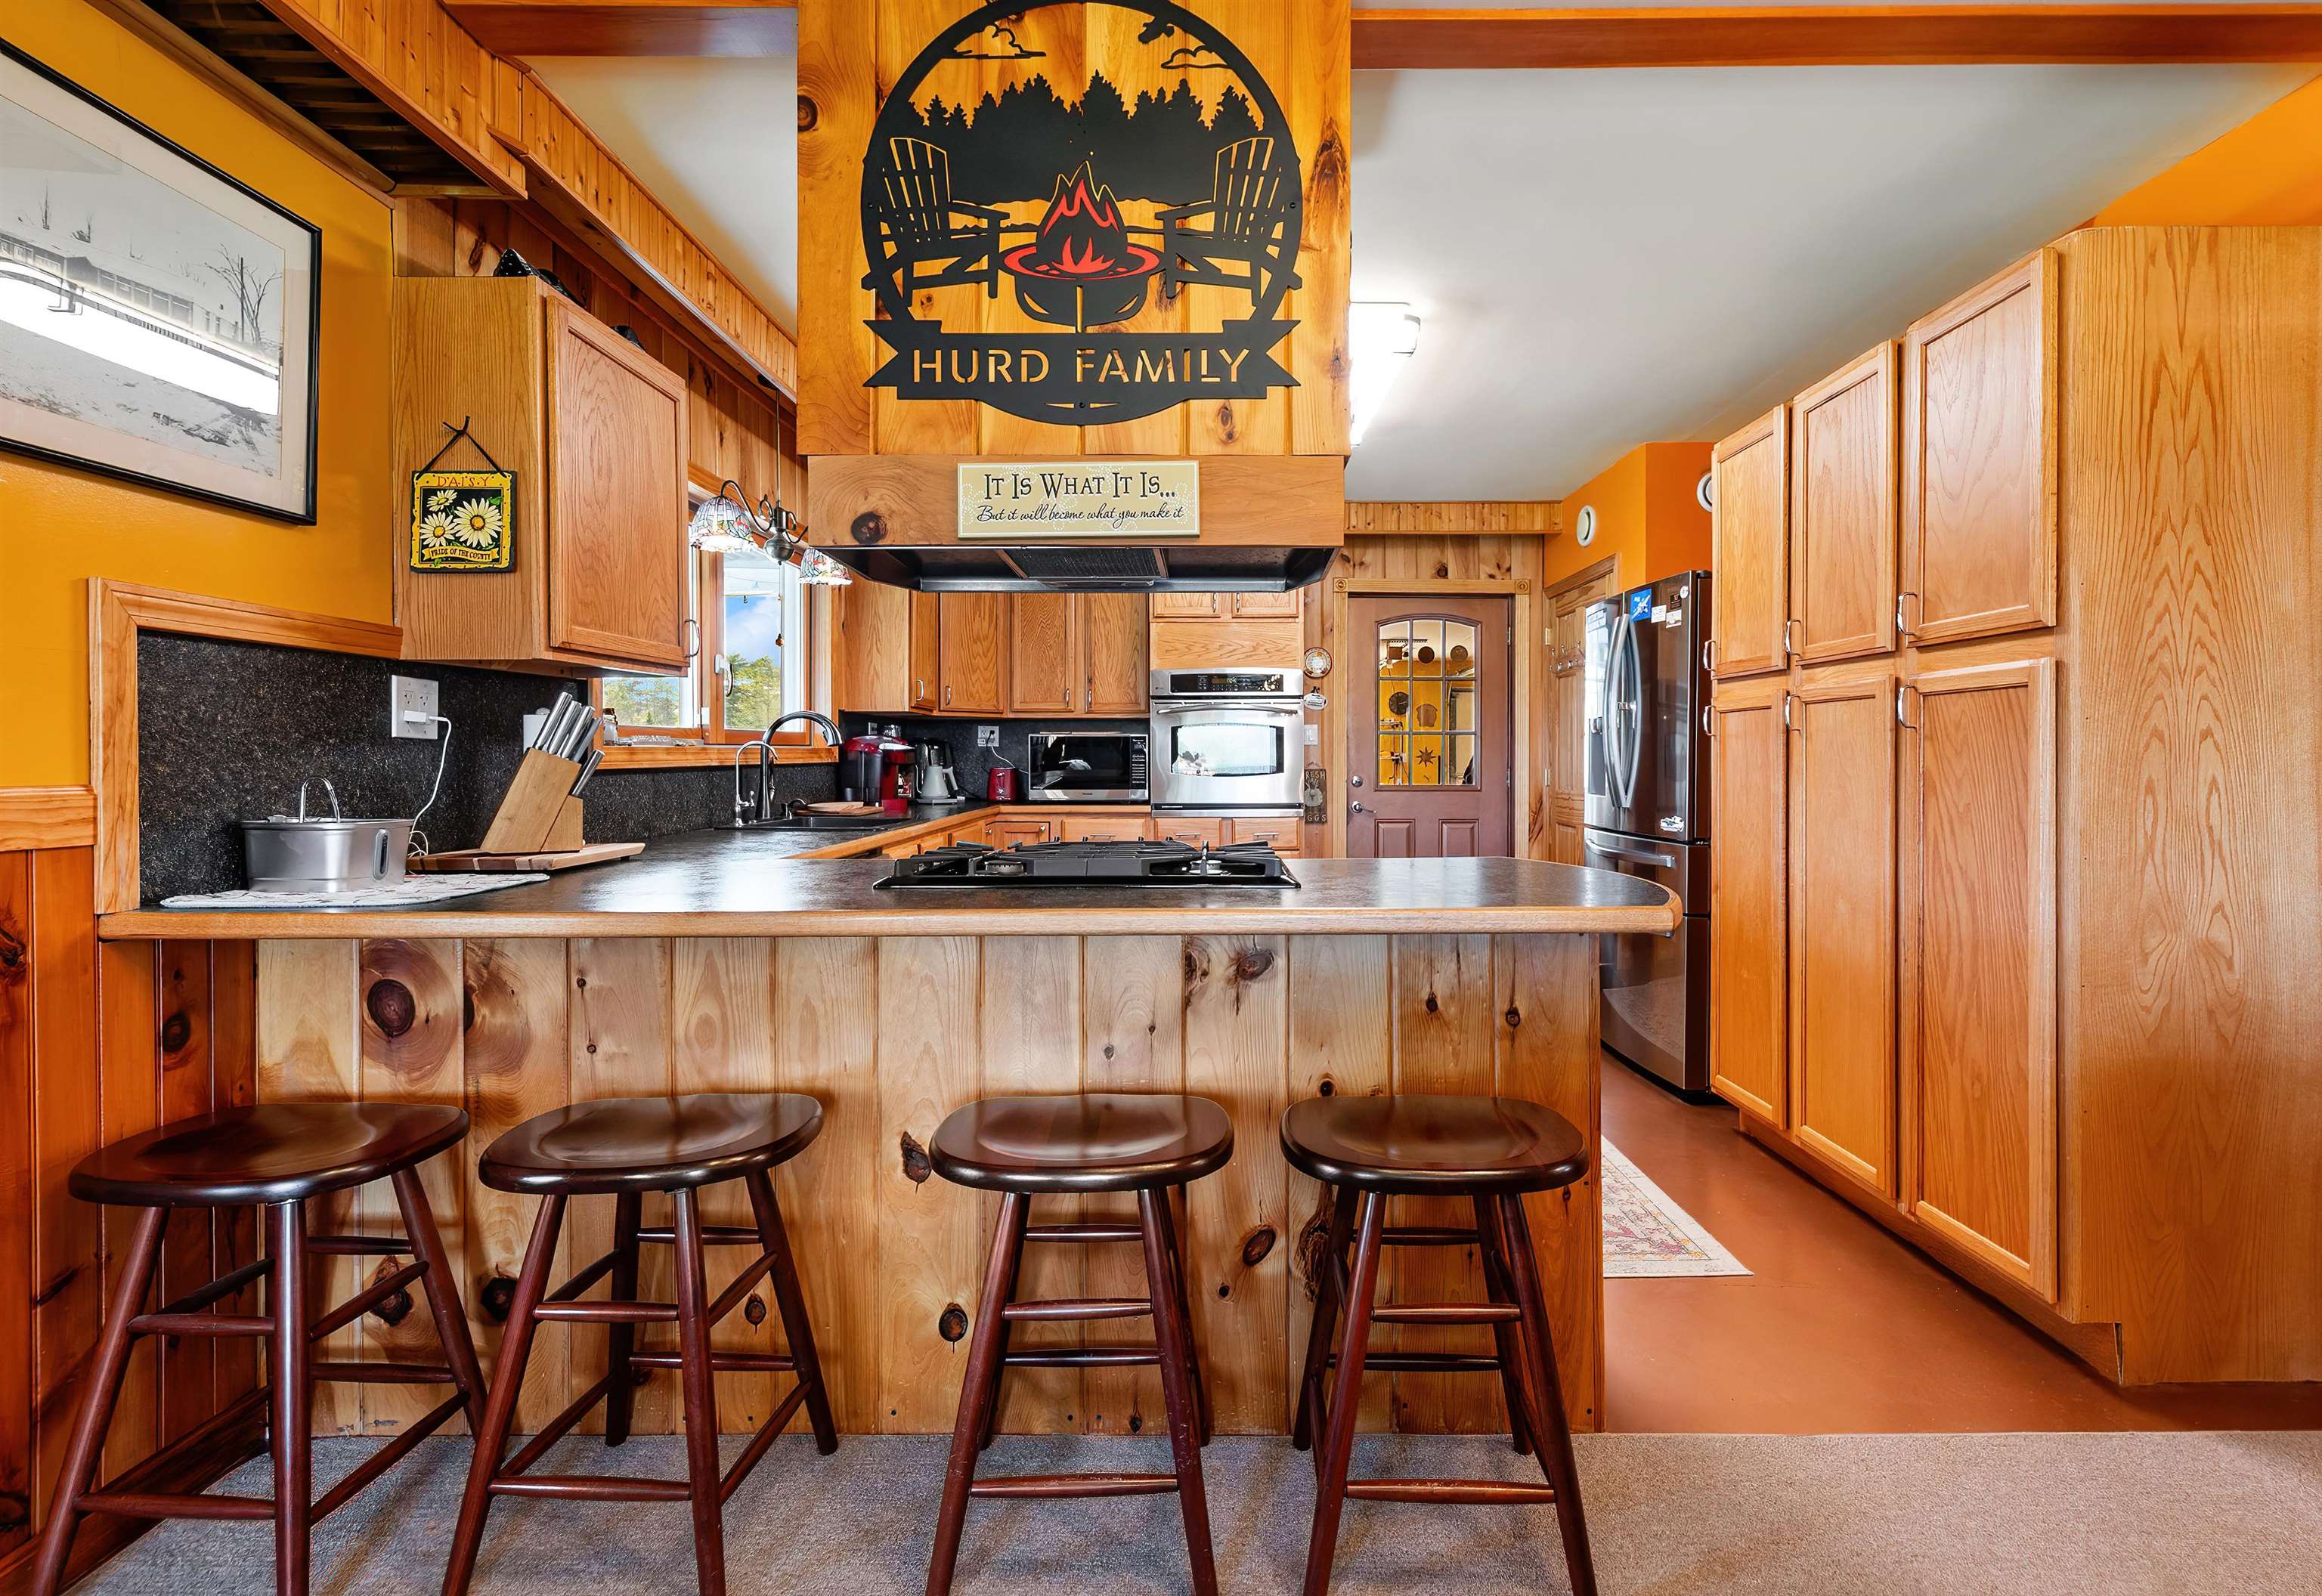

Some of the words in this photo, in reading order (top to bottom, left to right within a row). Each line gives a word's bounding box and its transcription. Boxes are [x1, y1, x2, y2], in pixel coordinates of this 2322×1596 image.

[913, 348, 1050, 383] HURD
[1076, 348, 1249, 383] FAMILY
[437, 476, 490, 487] DAISY
[977, 505, 1006, 521] But
[1008, 508, 1018, 520] it
[1020, 503, 1049, 521] will
[1048, 503, 1085, 521] become
[1086, 503, 1116, 520] what
[1112, 510, 1140, 529] you
[1140, 502, 1172, 519] make
[1172, 506, 1184, 518] it
[1305, 771, 1325, 781] RESH
